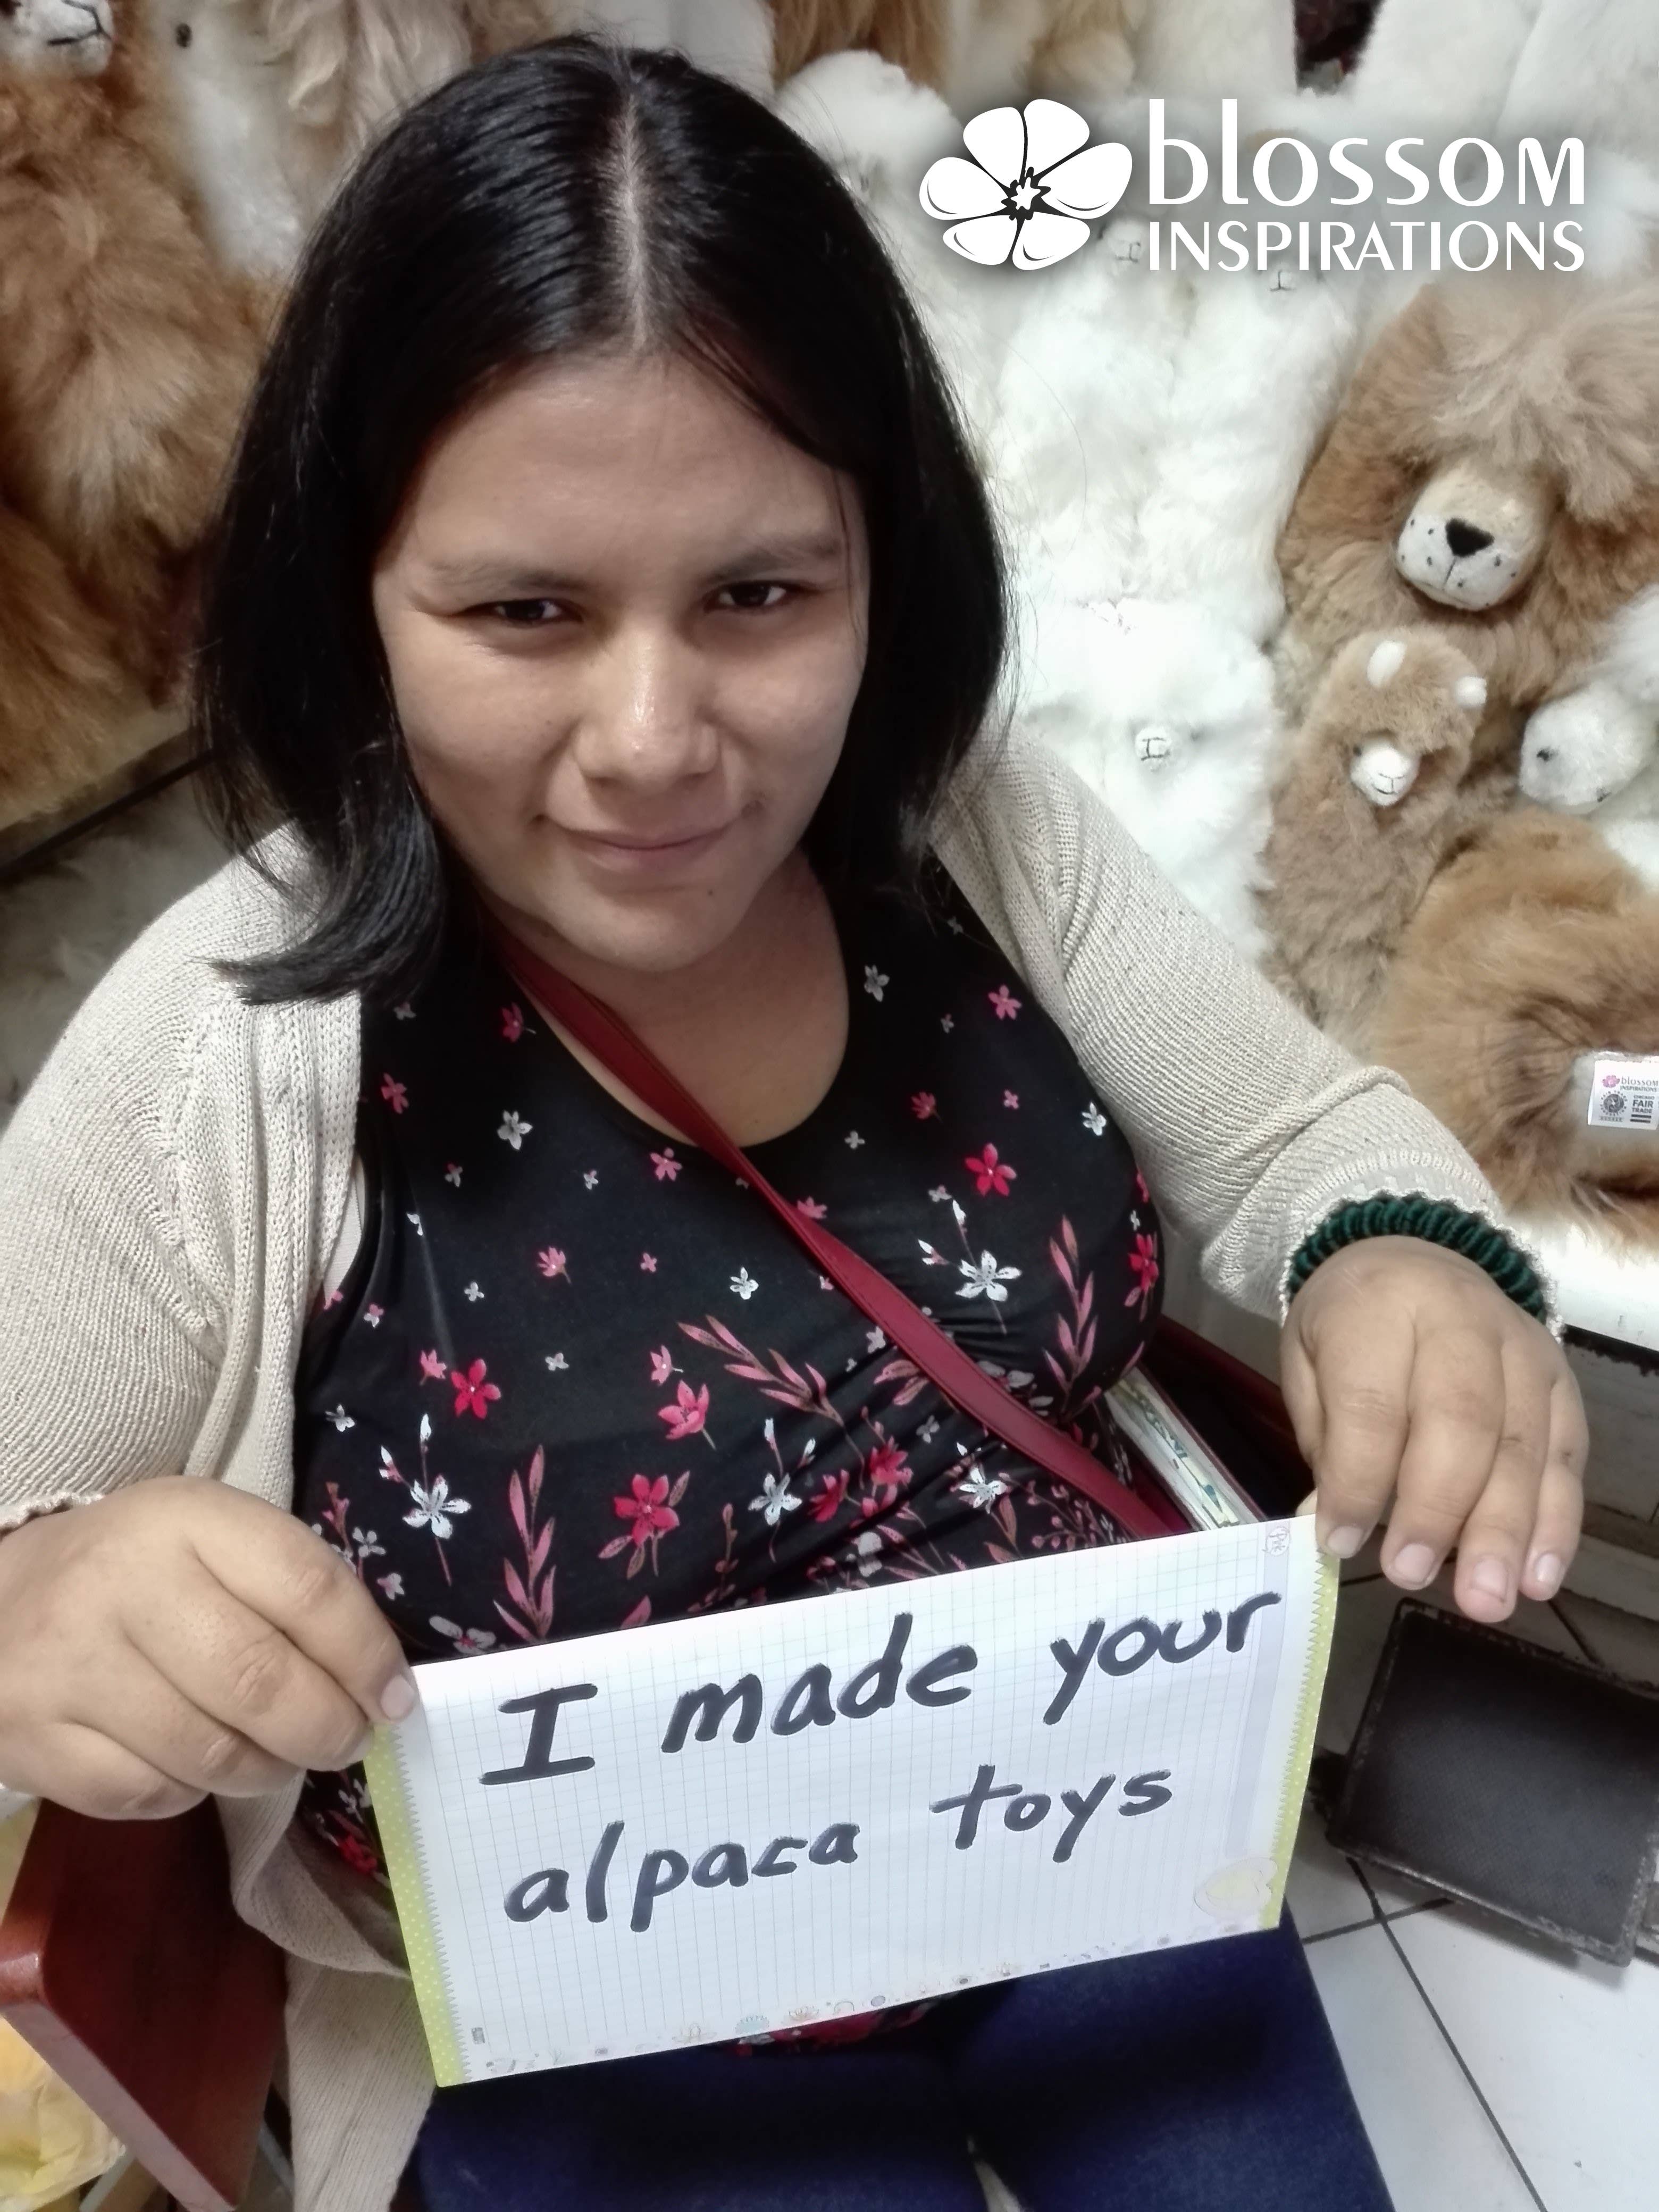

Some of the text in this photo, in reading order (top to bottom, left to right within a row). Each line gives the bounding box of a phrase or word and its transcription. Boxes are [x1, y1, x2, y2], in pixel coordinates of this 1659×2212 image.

[1632, 1100, 1654, 1108] FAIR
[479, 1593, 1281, 1786] I made your
[504, 1764, 1173, 1933] alpaca toys
